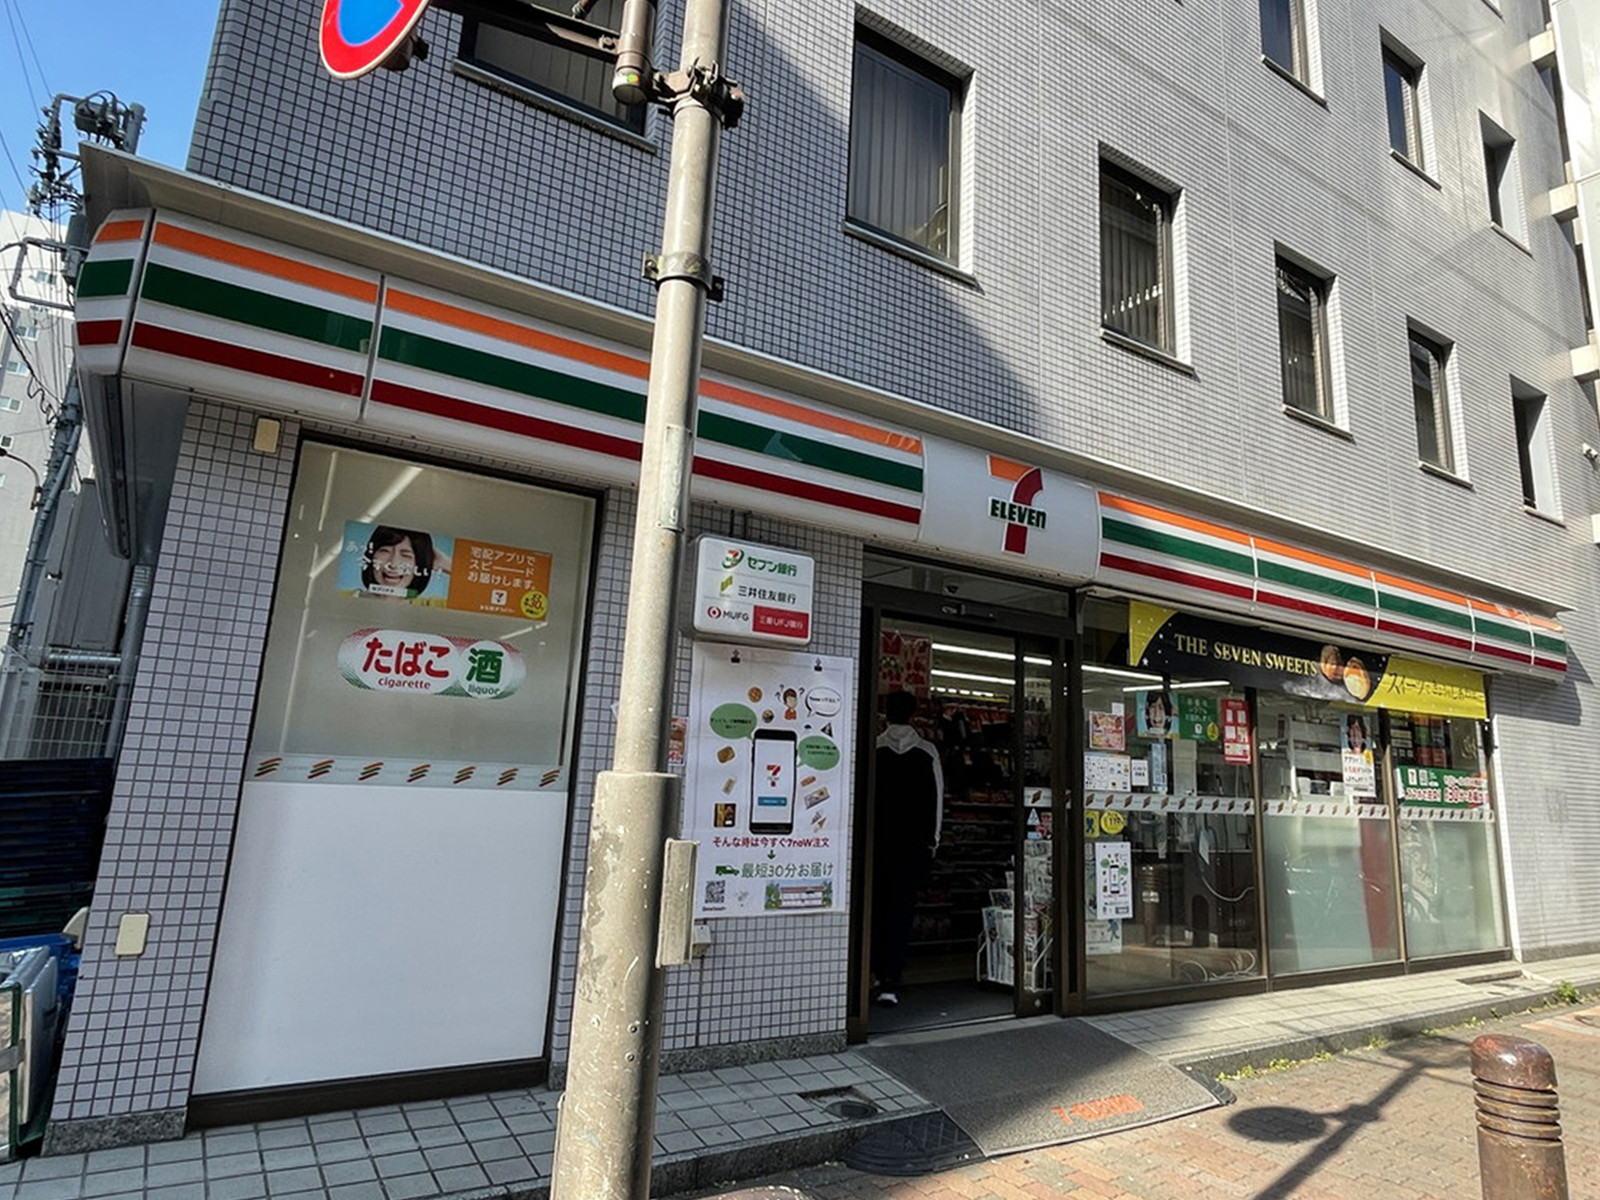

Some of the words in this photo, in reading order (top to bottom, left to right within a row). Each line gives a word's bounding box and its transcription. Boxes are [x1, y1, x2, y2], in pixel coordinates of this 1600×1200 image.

[747, 556, 797, 577] セブン銀行
[738, 585, 797, 605] 三井住友銀行
[723, 610, 749, 622] MUFG
[362, 637, 450, 679] たばこ
[466, 648, 503, 684] 酒
[1174, 634, 1208, 657] THE
[1213, 642, 1262, 667] SEVEN
[1265, 652, 1318, 677] SWEETS
[378, 678, 431, 690] cigarette
[468, 684, 500, 696] liquor
[741, 862, 833, 878] 最短30分お届け
